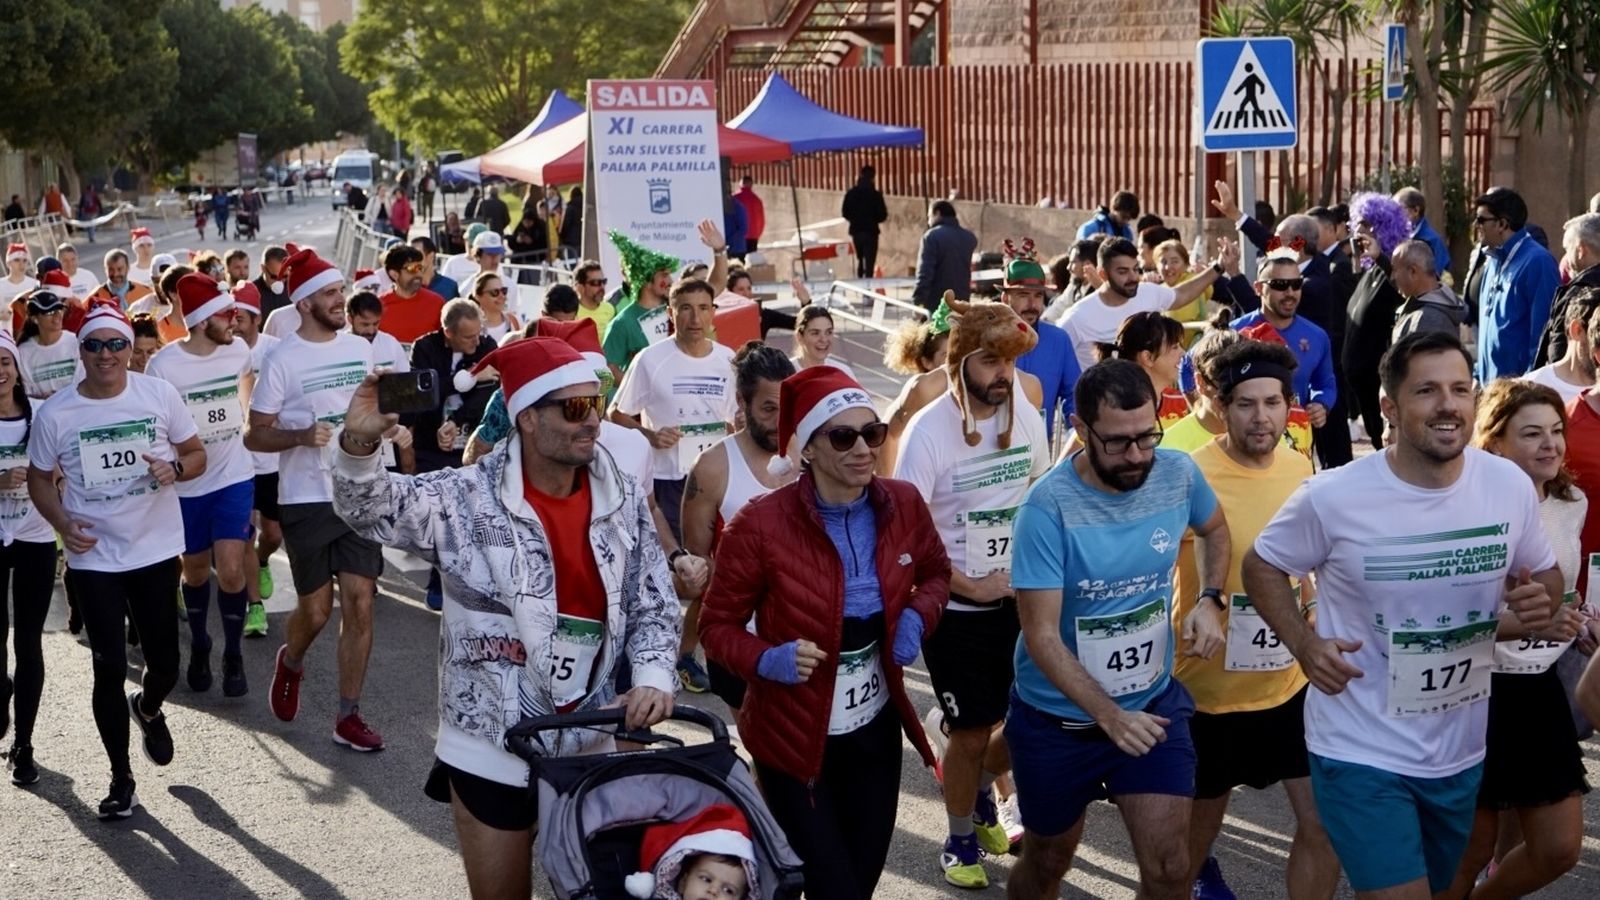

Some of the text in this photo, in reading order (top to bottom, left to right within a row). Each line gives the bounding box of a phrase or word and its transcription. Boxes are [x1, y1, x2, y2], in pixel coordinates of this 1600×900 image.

[597, 86, 709, 107] SALIDA
[607, 117, 703, 135] XI CARRERA
[608, 144, 707, 155] SAN SILVESTRE
[600, 161, 716, 172] PALMA PALMILLA
[630, 221, 695, 231] Ayuntamiento
[639, 231, 687, 242] de Málaga
[207, 407, 227, 424] 88
[101, 449, 136, 470] 120
[977, 477, 1003, 489] PALMA
[1455, 543, 1508, 558] CARRERA
[1437, 552, 1508, 568] SAN SILVESTRE
[1408, 560, 1508, 581] PALMA PALMILLA
[1107, 640, 1154, 672] 437
[1420, 658, 1473, 692] 177
[845, 673, 880, 710] 129
